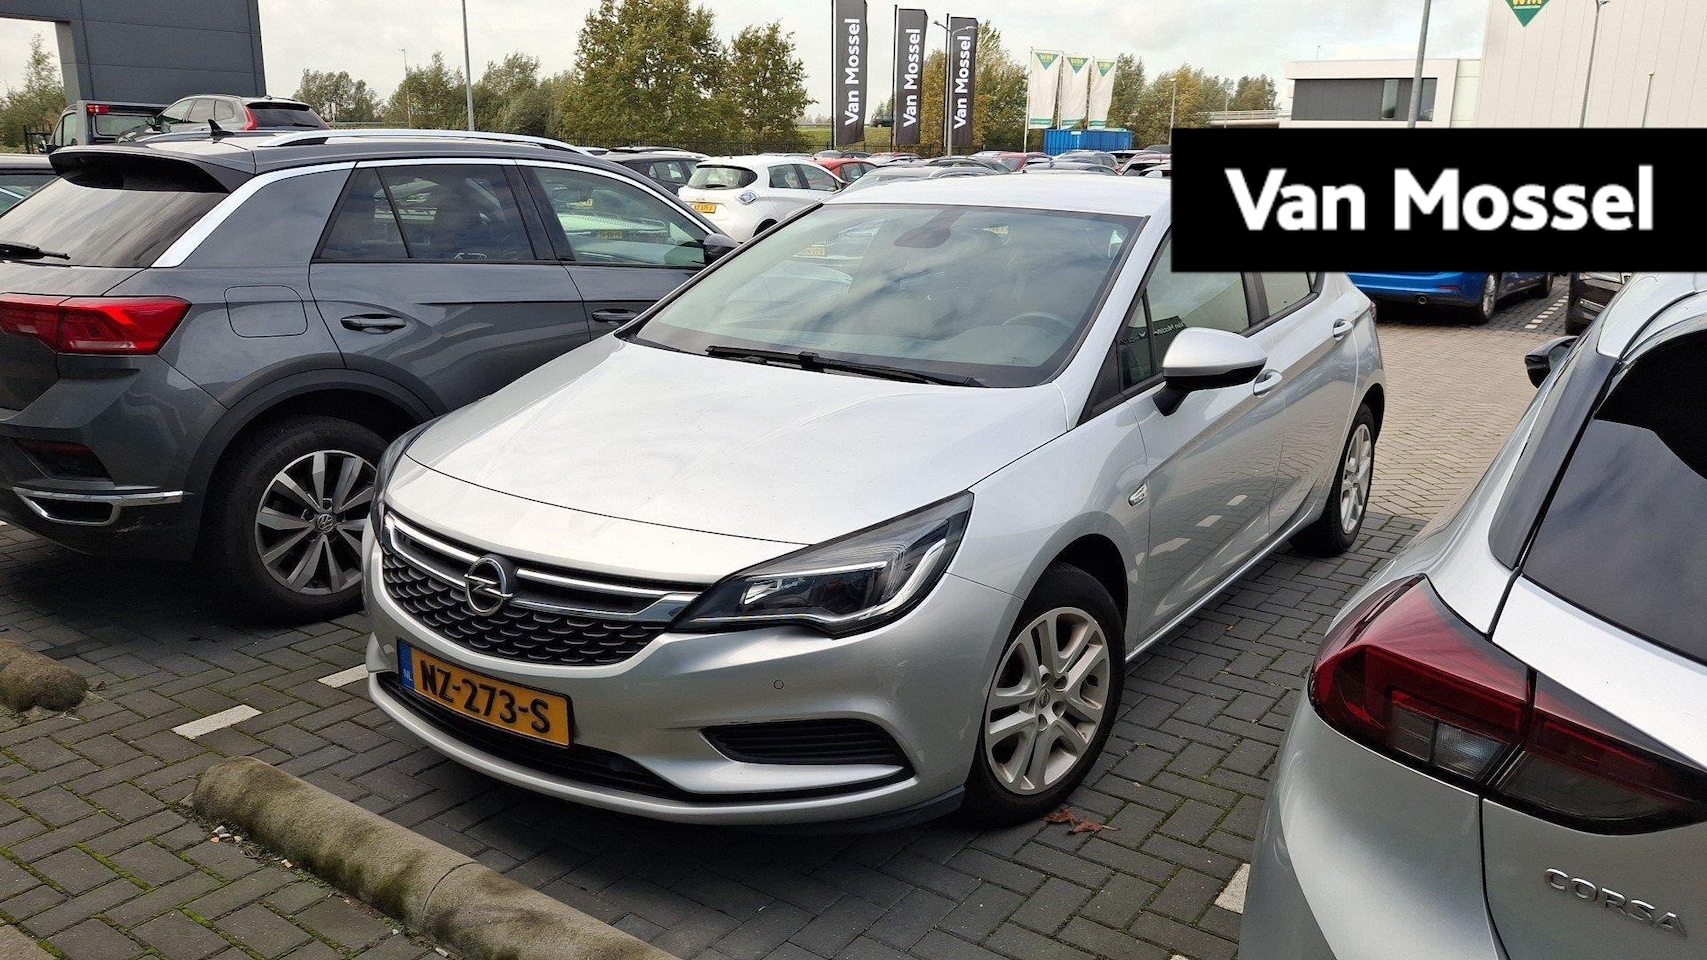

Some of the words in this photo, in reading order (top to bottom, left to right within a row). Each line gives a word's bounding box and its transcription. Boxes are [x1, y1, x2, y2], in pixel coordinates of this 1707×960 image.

[844, 18, 861, 85] Mossel
[903, 28, 921, 90] Mossel
[954, 35, 971, 94] Mossel
[844, 90, 860, 126] Van
[903, 95, 918, 128] Van
[953, 98, 968, 129] Van
[403, 668, 413, 682] NL
[420, 659, 551, 735] NZ-273-S
[1544, 867, 1688, 938] CORSA
